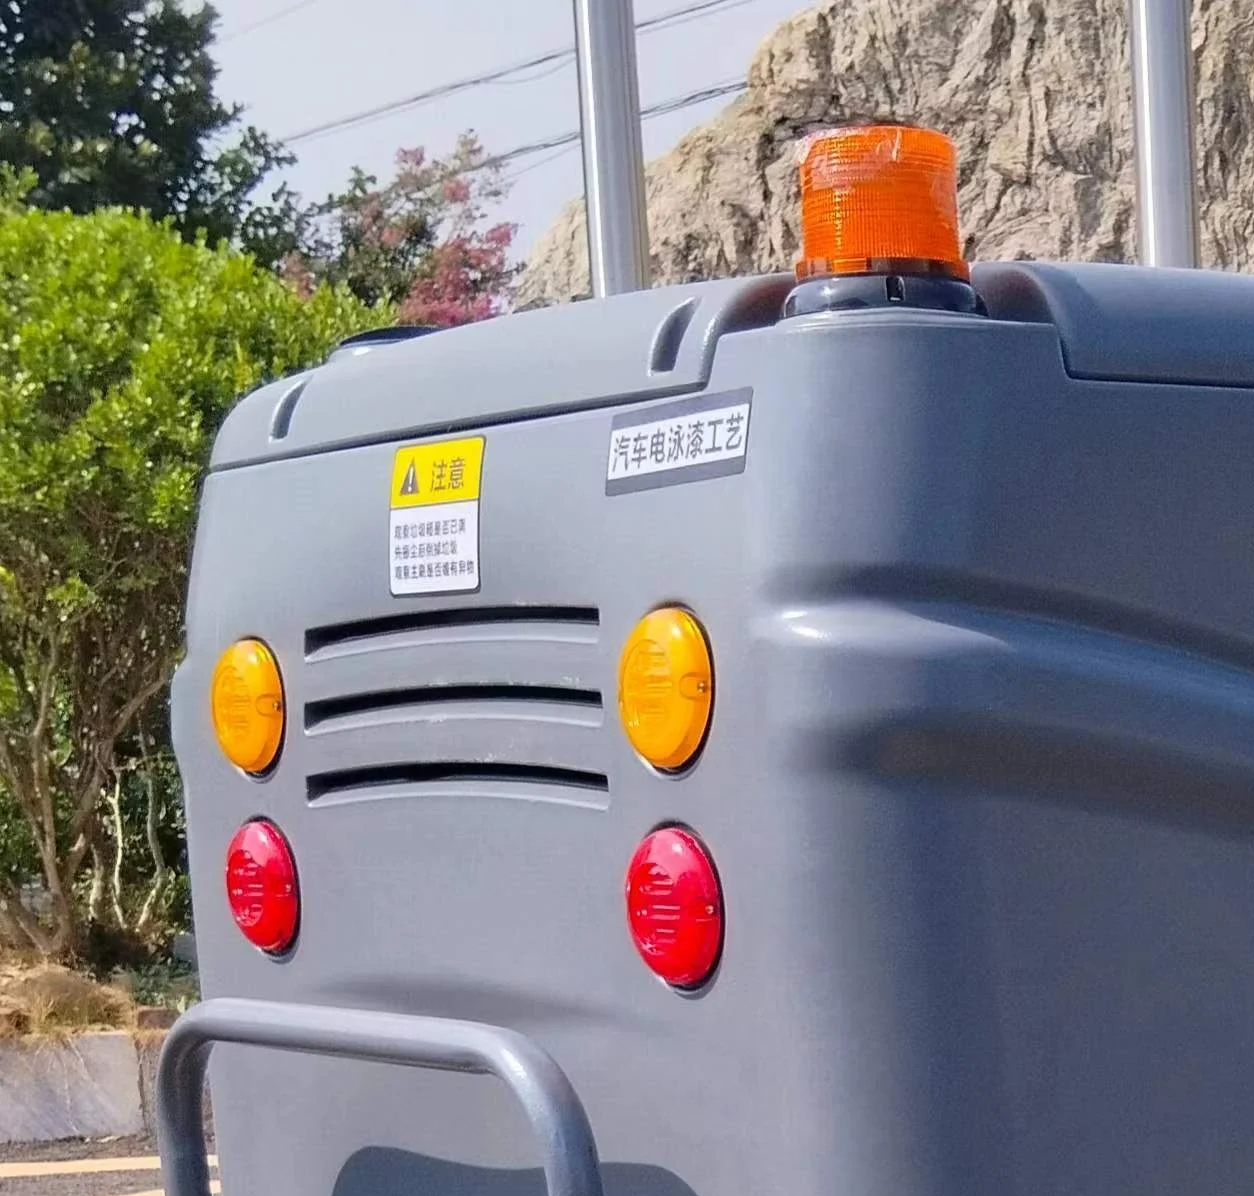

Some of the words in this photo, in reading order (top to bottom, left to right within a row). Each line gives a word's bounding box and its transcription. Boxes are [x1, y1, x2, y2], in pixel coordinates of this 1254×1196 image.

[612, 412, 744, 473] 汽车电泳漆工艺
[430, 457, 465, 492] 注意
